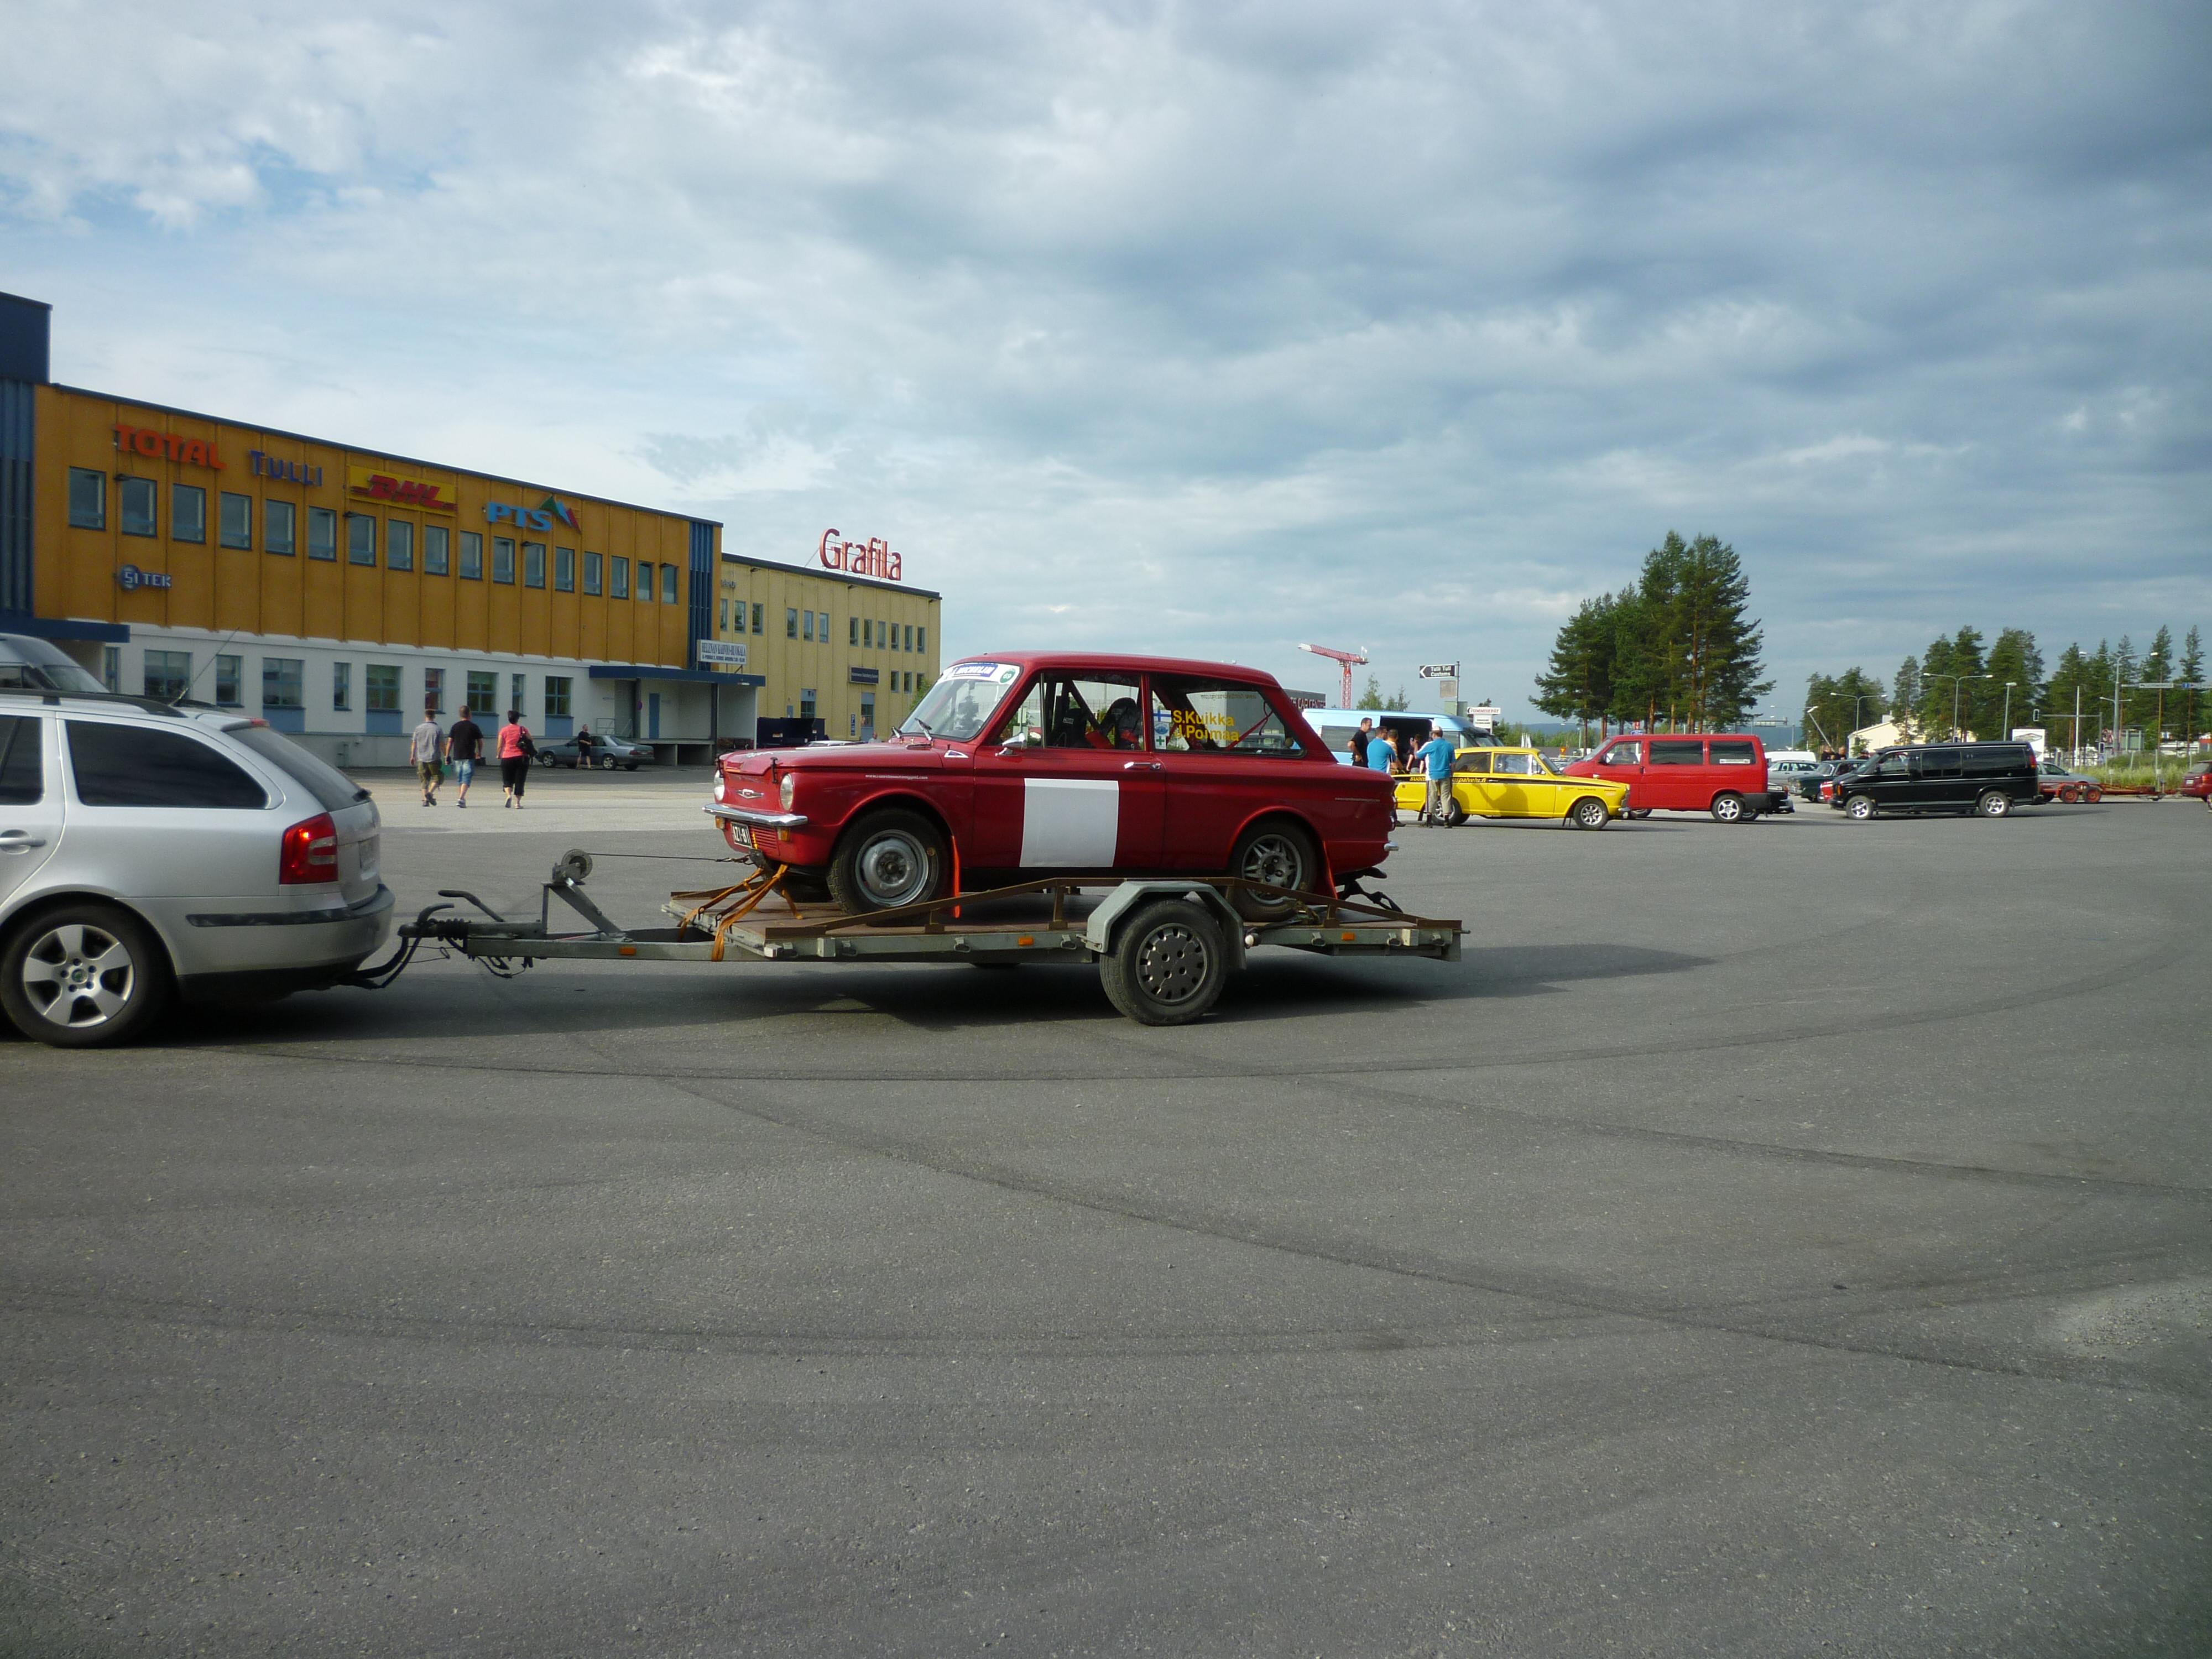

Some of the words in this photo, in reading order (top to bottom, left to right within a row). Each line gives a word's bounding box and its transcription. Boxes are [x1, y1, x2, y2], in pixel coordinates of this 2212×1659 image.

[114, 423, 227, 469] TOTAL
[249, 450, 322, 487] TULLI
[368, 474, 445, 509] DHL
[486, 502, 552, 531] PTS
[820, 528, 902, 581] Grafila
[955, 665, 996, 675] MICHELIN
[1297, 697, 1309, 709] CAR
[1173, 709, 1235, 727] S.Kuikka
[1174, 724, 1239, 742] J.Poimaa
